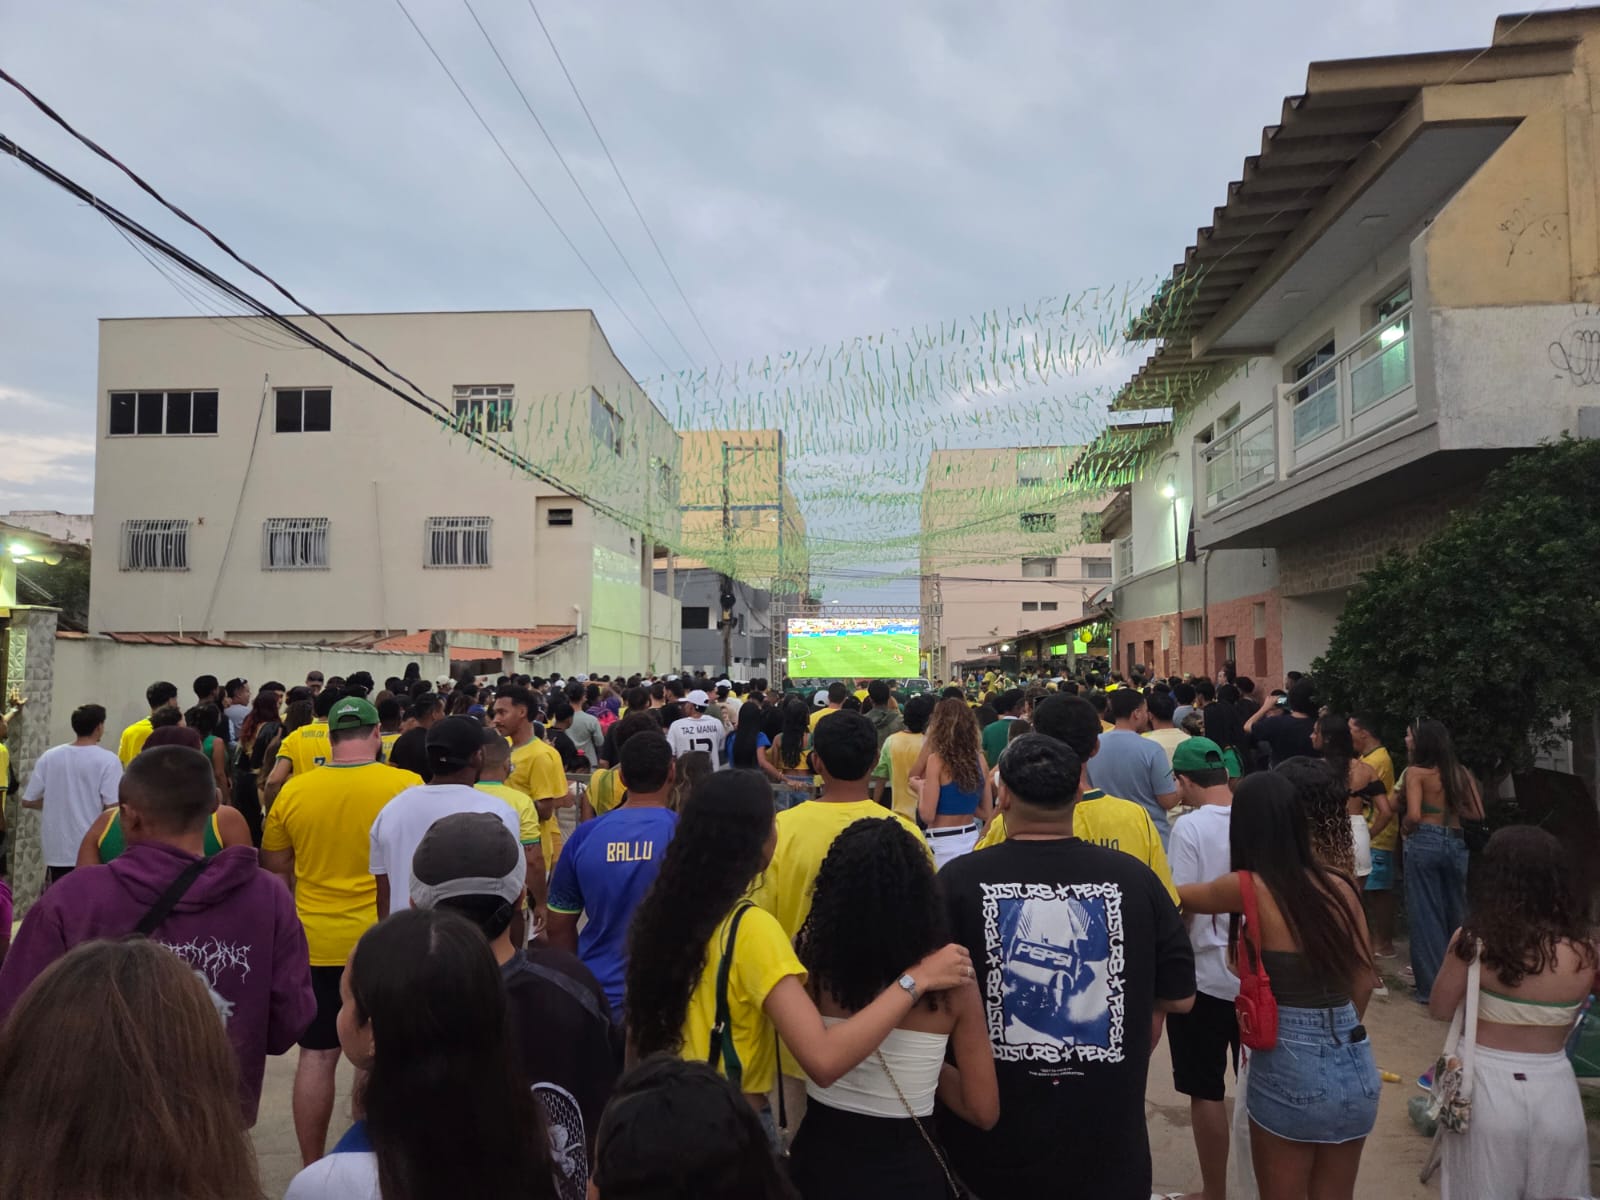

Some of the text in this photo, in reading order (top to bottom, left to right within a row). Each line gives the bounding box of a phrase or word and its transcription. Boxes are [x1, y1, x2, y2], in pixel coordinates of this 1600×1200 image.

[681, 724, 718, 735] TAZ MANIA
[607, 841, 653, 862] BALLU
[980, 882, 1122, 900] DISTURB PEPSI
[1015, 943, 1072, 967] PEPSI
[983, 899, 1004, 1042] DISTURB PEPSI
[1106, 899, 1125, 1050] DISTURB PEPSI
[992, 1044, 1125, 1063] DISTURB PEPSI
